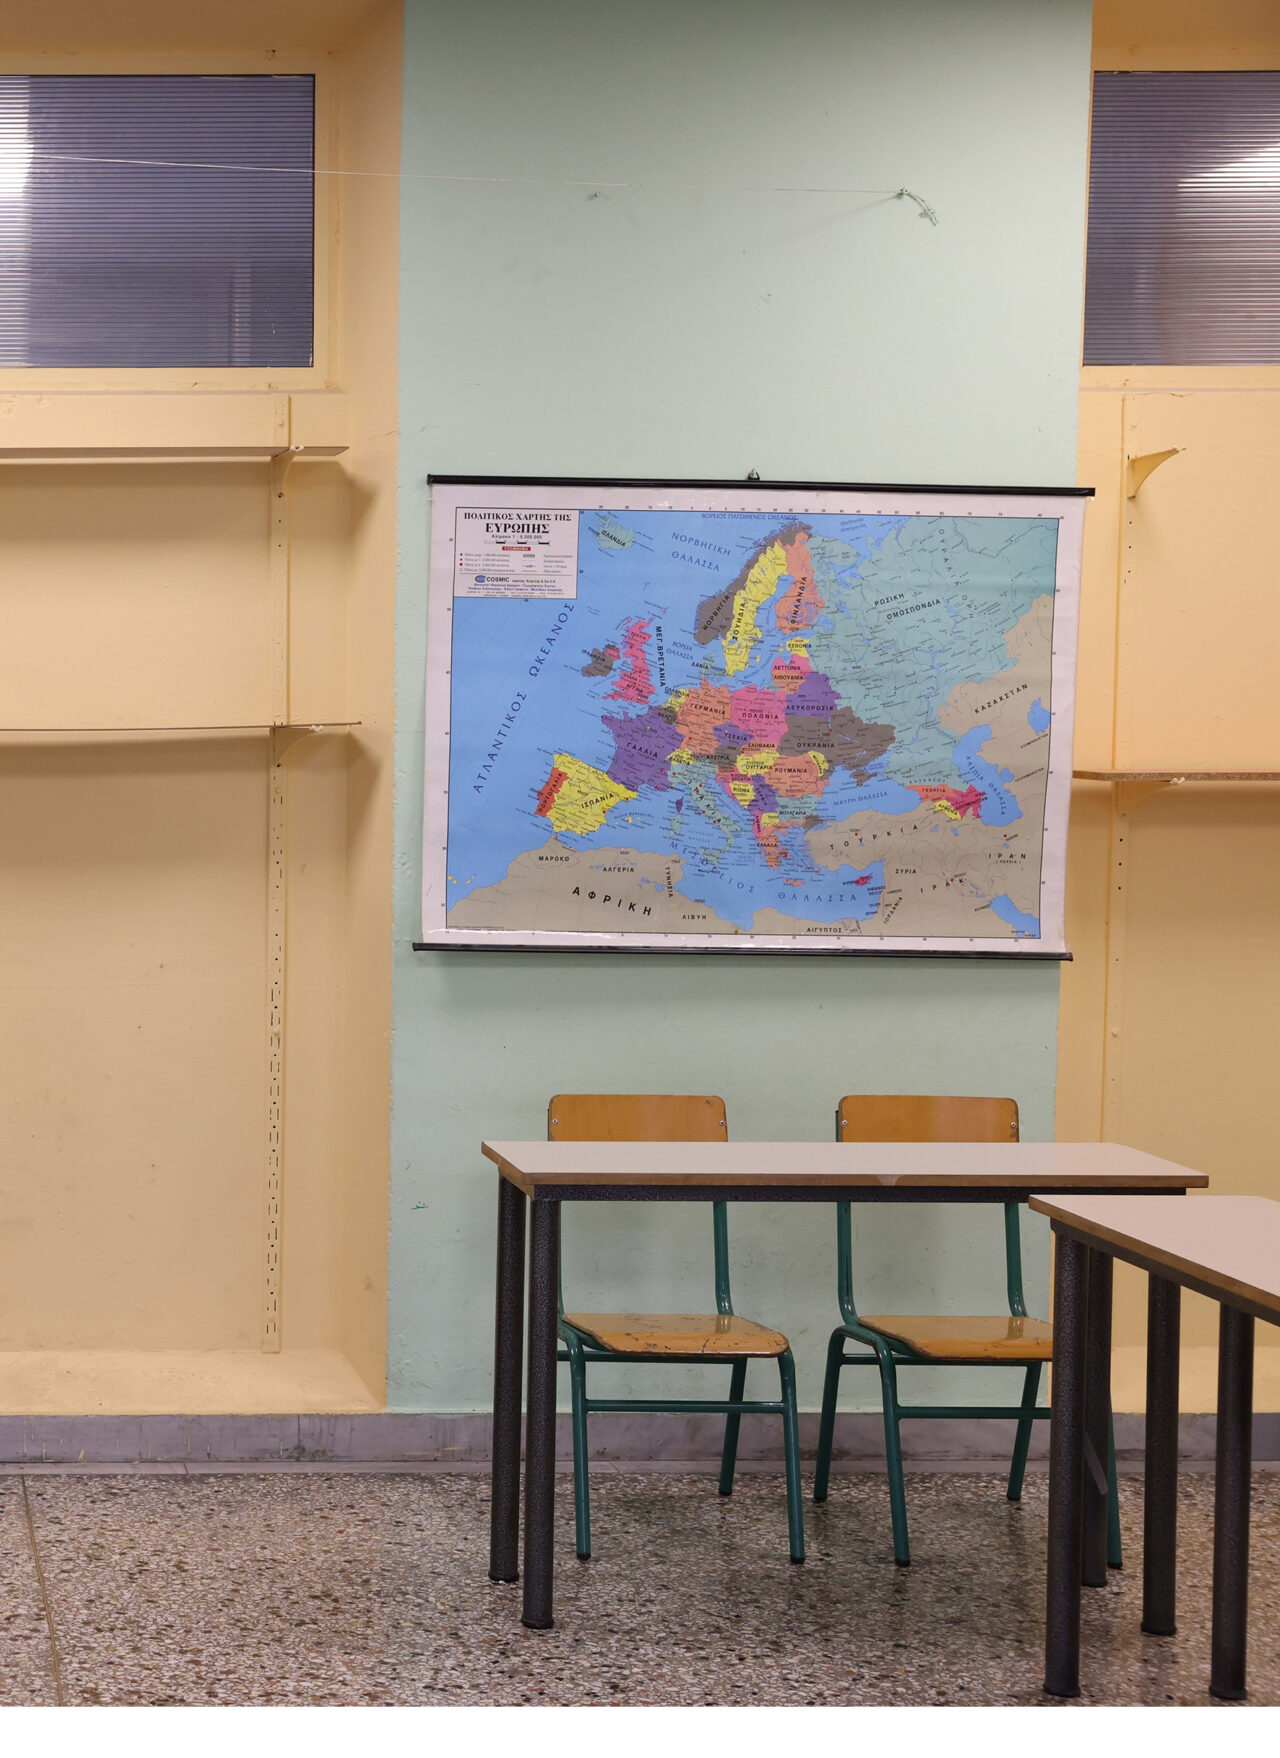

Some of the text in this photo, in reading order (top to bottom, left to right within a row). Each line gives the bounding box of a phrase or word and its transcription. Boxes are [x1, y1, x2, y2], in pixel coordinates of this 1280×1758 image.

[464, 512, 513, 521] ΠΟΛΙΤΙΚΟΣ
[516, 513, 552, 521] ΧΑΡΤΗΣ
[485, 522, 550, 534] ΕΥΡΩΠΗΣ
[671, 532, 732, 557] ΝΟΡΒΗΓΙΚΗ
[671, 551, 720, 573] ΘΑΛΑΣΣΑ
[790, 575, 808, 625] ΦΙΝΛΑΝΔΙΑ
[874, 592, 905, 607] ΡΩΣΙΚΗ
[886, 598, 942, 621] ΟΜΟΣΠΟΝΔΙΑ
[703, 594, 731, 631] ΝΟΡΒΗΓΙΑ
[732, 602, 746, 641] ΣΟΥΗΔΙΑ
[473, 691, 527, 794] ΑΤΛΑΝΤΙΚΟΣ
[528, 602, 575, 678] ΩΚΕΑΝΟΣ
[690, 702, 726, 715] ΓΕΡΜΑΝΙΑ
[626, 742, 658, 758] ΓΑΛΛΙΑ
[581, 792, 615, 809] ΙΣΠΑΝΙΑ
[830, 824, 918, 850] ΤΟΥΡΚΙΑ
[572, 886, 652, 916] ΑΦΡΙΚΗ
[778, 891, 857, 902] ΘΑΛΑΣΣΑ
[883, 896, 903, 924] ΙΟΡΔΑΝΙΑ
